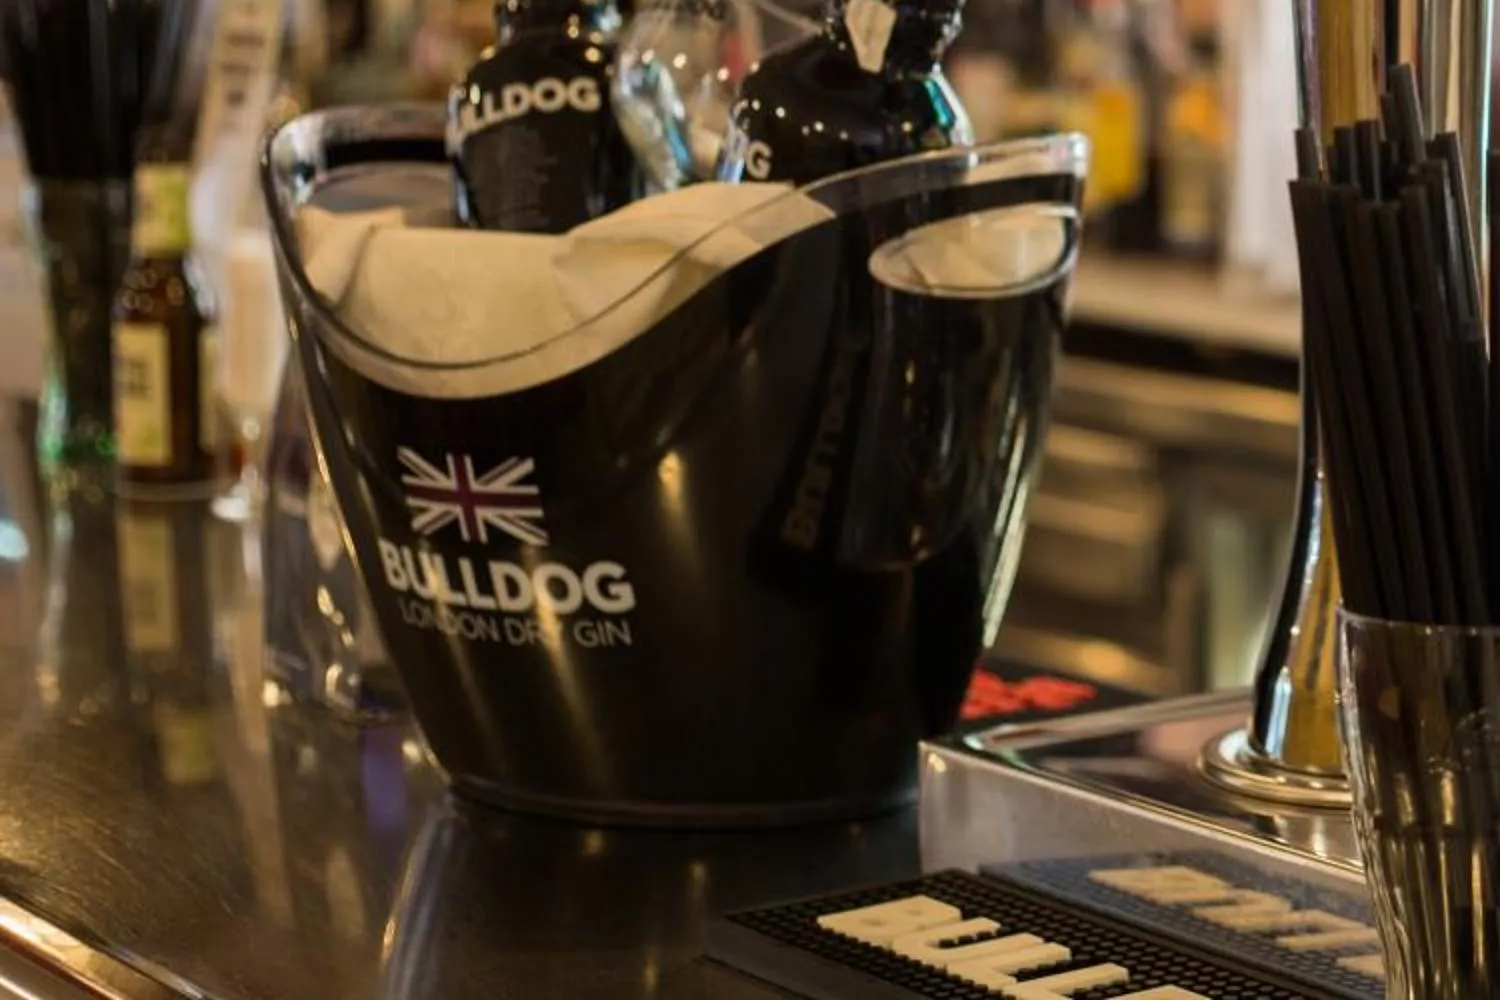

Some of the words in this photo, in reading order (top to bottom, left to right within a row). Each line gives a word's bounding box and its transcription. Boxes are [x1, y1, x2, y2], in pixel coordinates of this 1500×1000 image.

[377, 535, 637, 614] BULLDOG
[503, 615, 565, 647] DR
[572, 619, 632, 649] GIN
